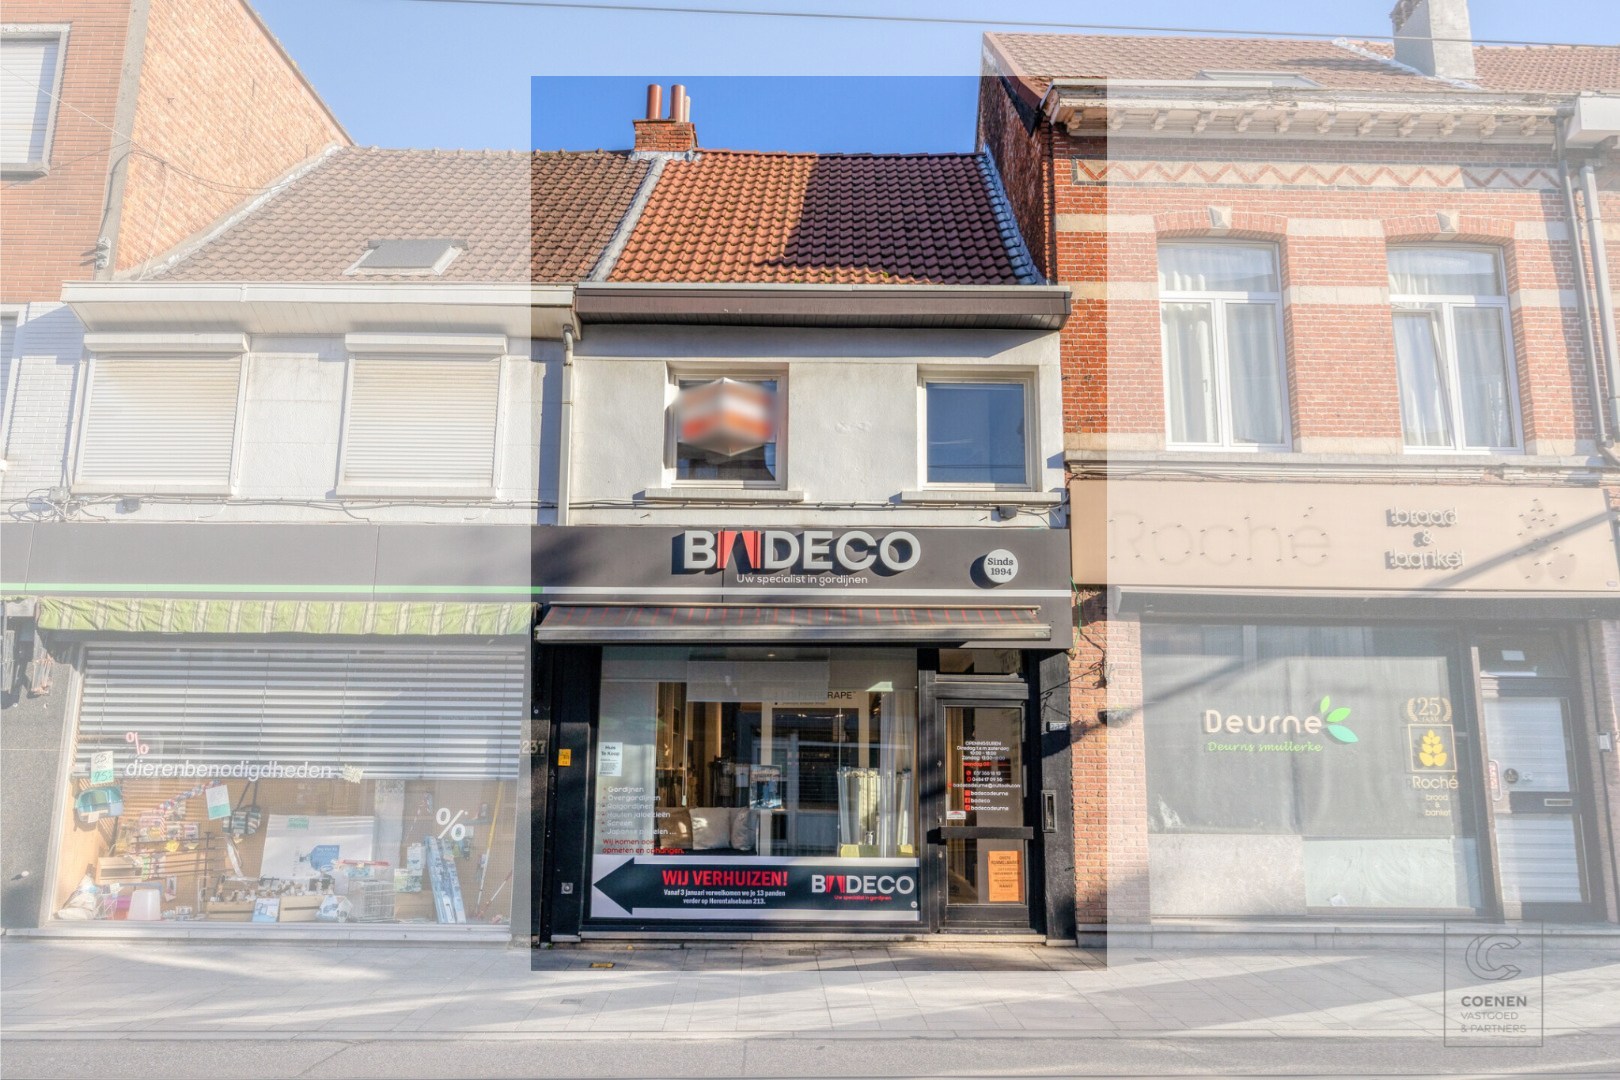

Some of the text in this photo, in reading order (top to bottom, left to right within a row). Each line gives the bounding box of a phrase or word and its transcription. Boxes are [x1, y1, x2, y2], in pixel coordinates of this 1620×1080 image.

[1394, 505, 1458, 525] brood
[1422, 528, 1436, 544] &
[987, 556, 1014, 566] Sinds
[990, 567, 1012, 576] 1994
[736, 573, 868, 587] Uw specialist in gordijnen
[1415, 697, 1441, 716] 25
[1205, 709, 1323, 734] Deurne
[126, 760, 332, 782] dierenbenodigdheden
[1412, 775, 1459, 789] Roché
[662, 870, 788, 887] WIJ VERHUIZEN!
